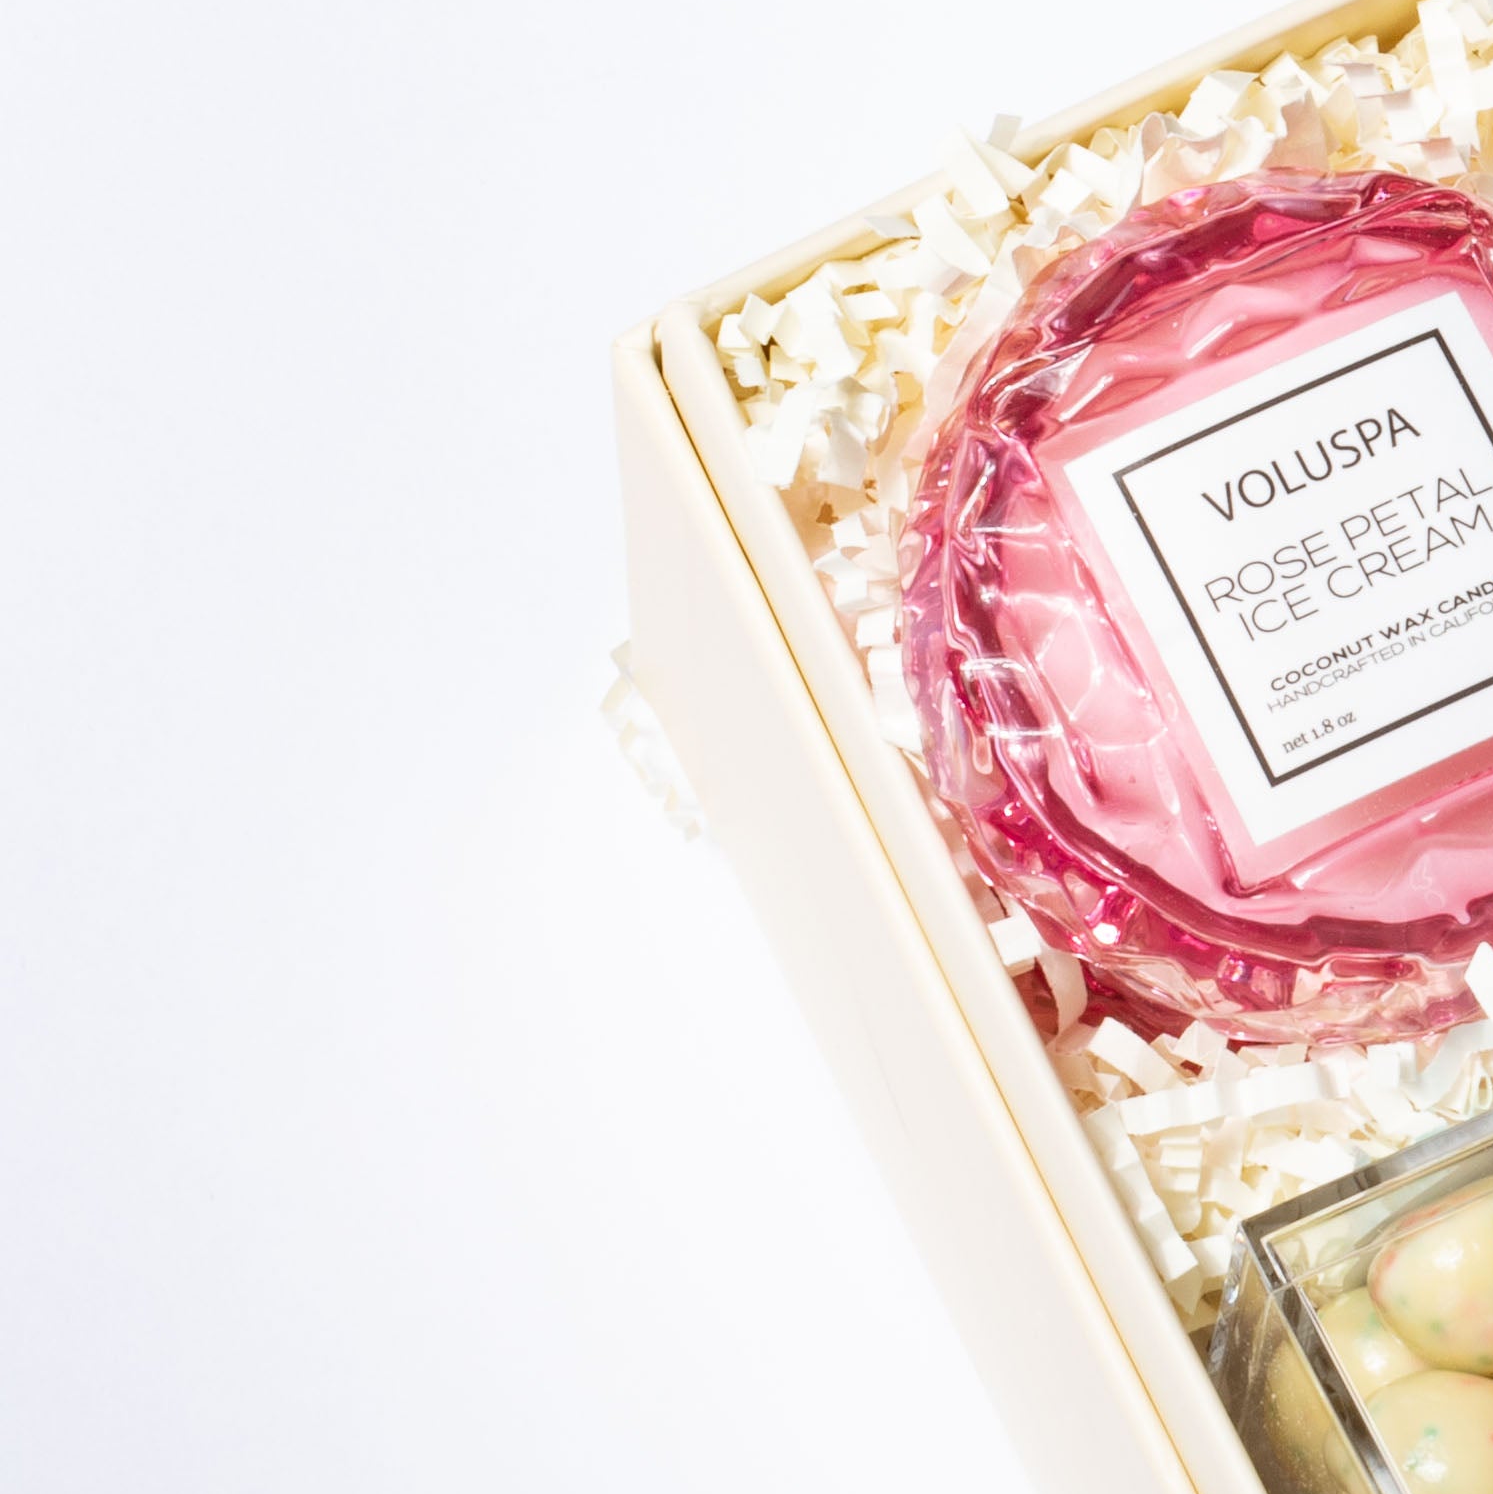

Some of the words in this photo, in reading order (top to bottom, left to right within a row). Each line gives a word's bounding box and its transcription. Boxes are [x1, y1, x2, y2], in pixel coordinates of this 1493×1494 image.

[1201, 408, 1420, 522] VOLUSPA
[1204, 531, 1337, 612] ROSE
[1340, 468, 1493, 550] PETAL
[1239, 584, 1319, 641] ICE
[1327, 504, 1493, 598] CREAM
[1267, 642, 1405, 713] HANDCRAFTED
[1409, 632, 1427, 648] IN
[1271, 635, 1374, 692] COCONUT
[1379, 609, 1434, 640] WAX
[1283, 733, 1309, 754] net
[1312, 719, 1335, 740] 1.8
[1337, 710, 1357, 729] oz
